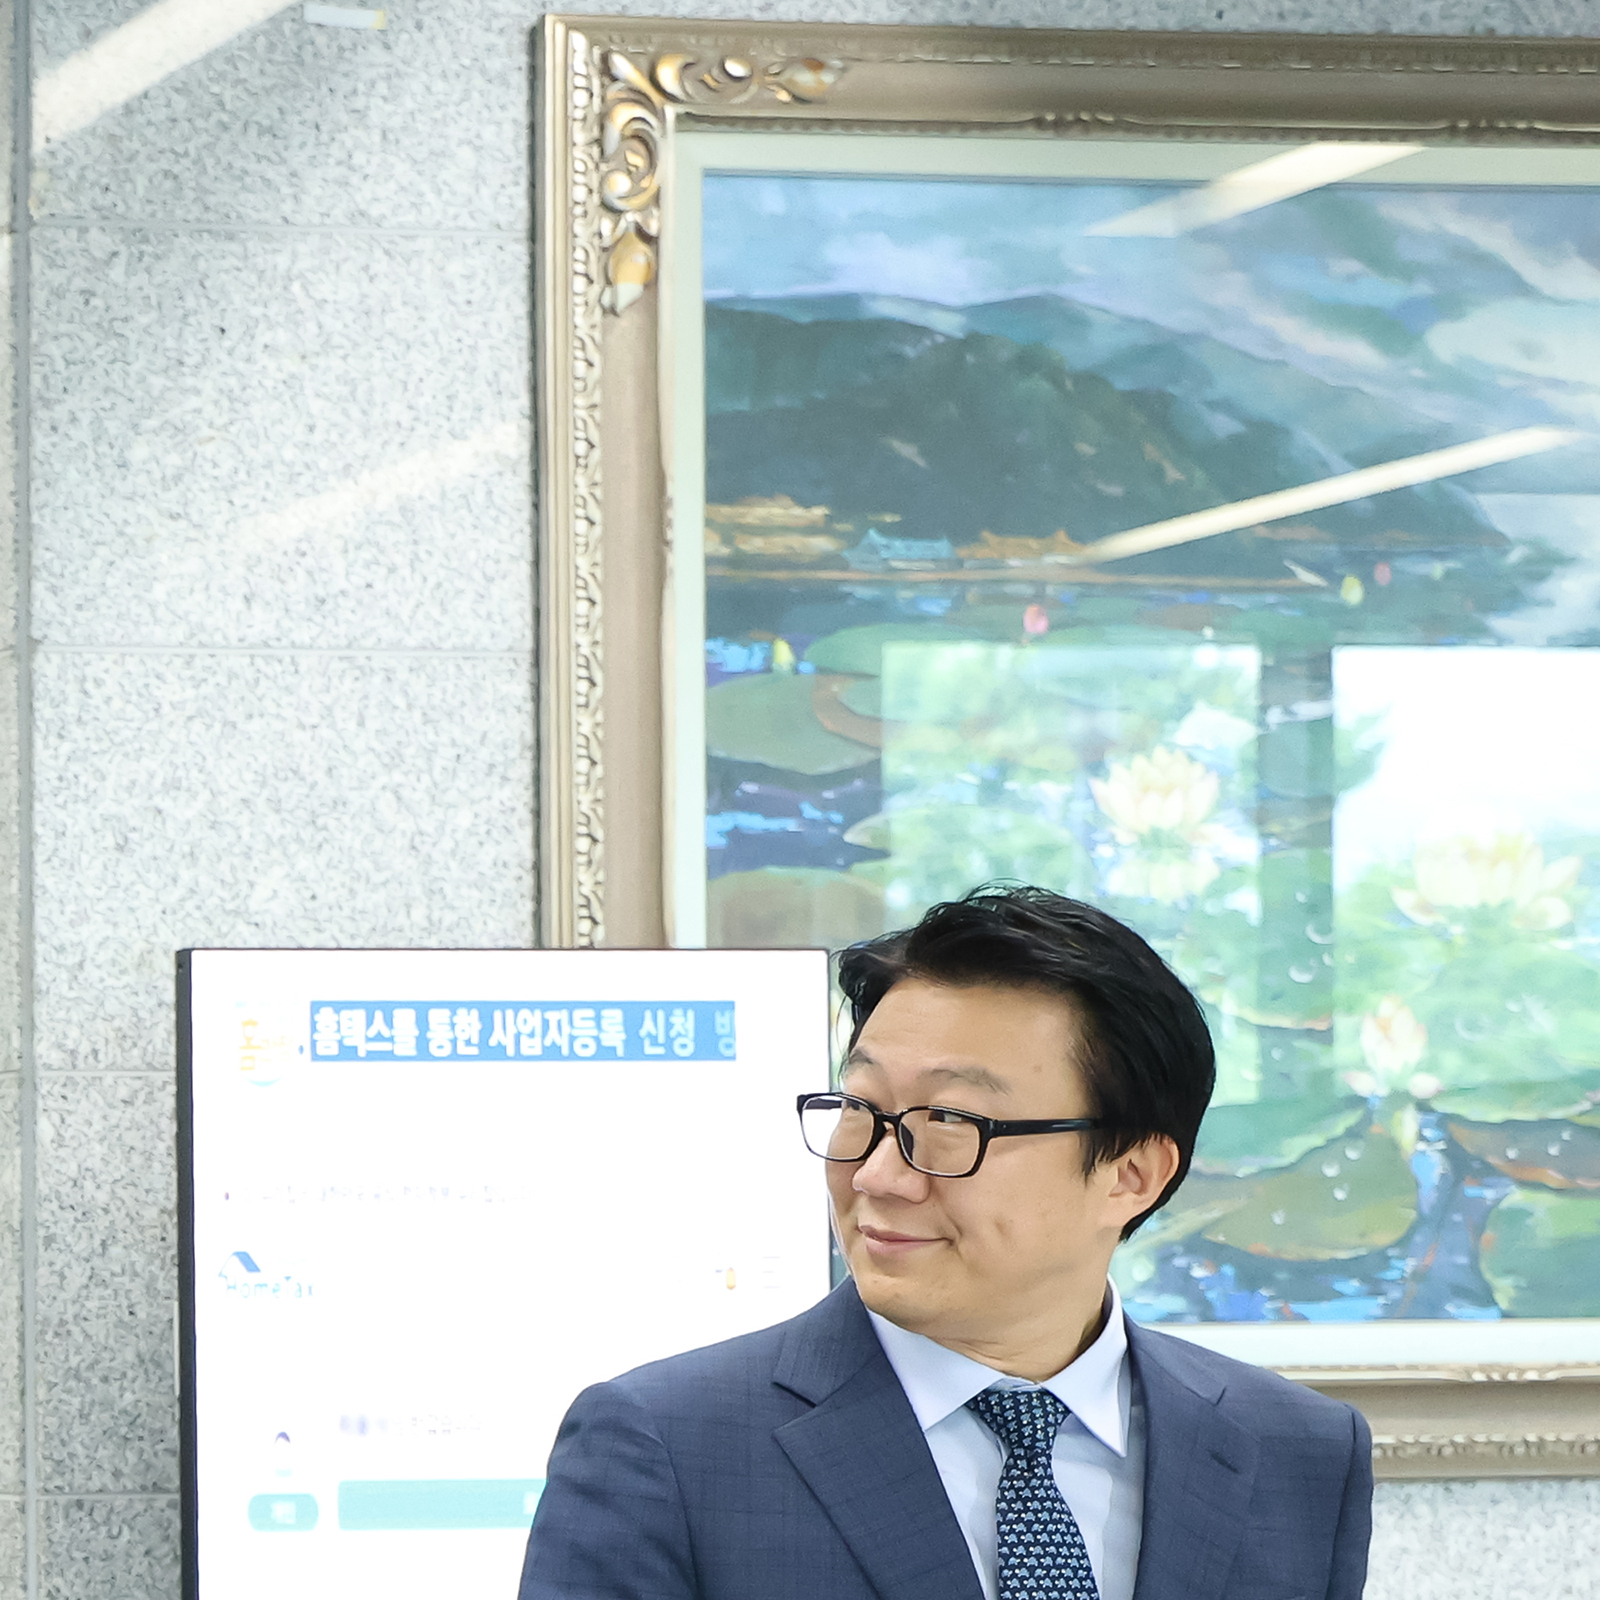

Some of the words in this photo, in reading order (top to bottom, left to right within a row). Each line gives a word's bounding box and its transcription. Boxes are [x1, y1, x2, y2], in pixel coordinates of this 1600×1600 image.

[313, 1007, 420, 1058] 홈택스를
[426, 1007, 482, 1058] 통한
[488, 1006, 627, 1058] 사업자등록
[638, 1006, 697, 1056] 신청
